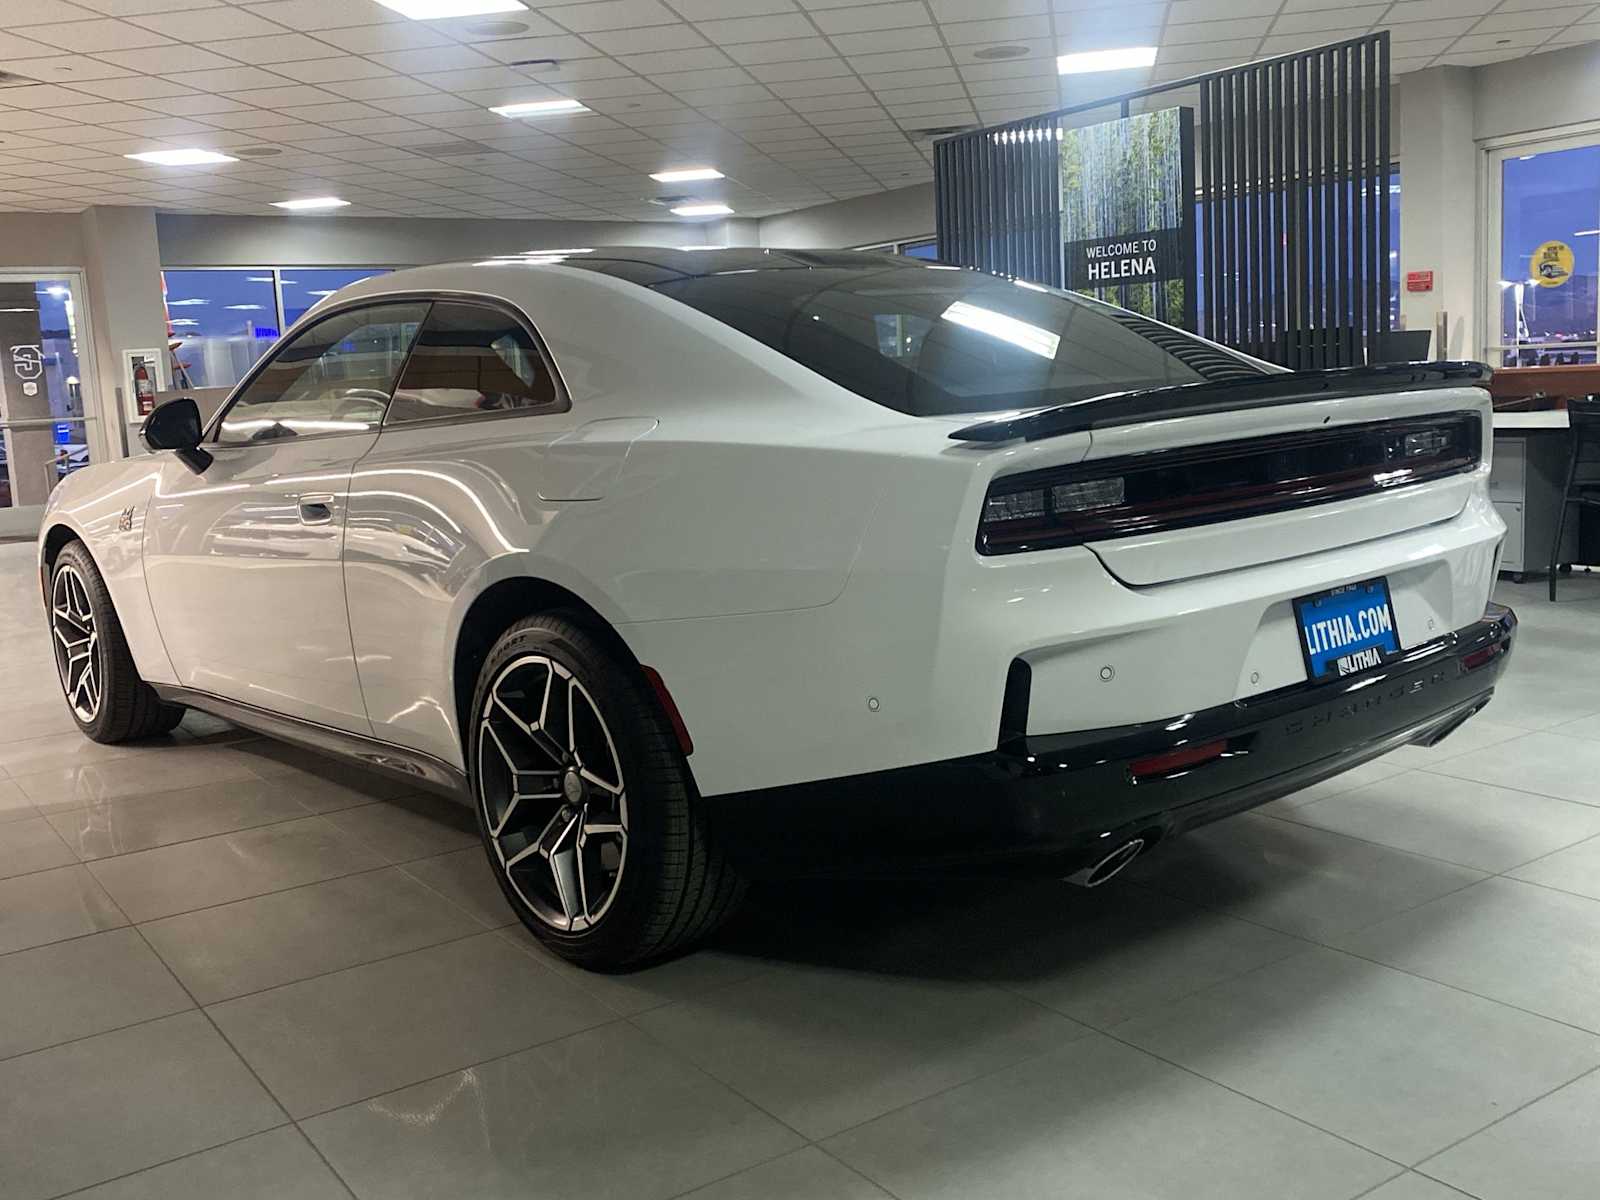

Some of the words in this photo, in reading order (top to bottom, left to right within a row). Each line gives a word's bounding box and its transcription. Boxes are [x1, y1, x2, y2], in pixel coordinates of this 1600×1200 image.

[1086, 241, 1139, 258] WELCOME
[1142, 239, 1157, 252] TO
[1088, 257, 1156, 280] HELENA
[1304, 603, 1392, 655] LITHIA.COM
[1347, 647, 1381, 673] LITHIA
